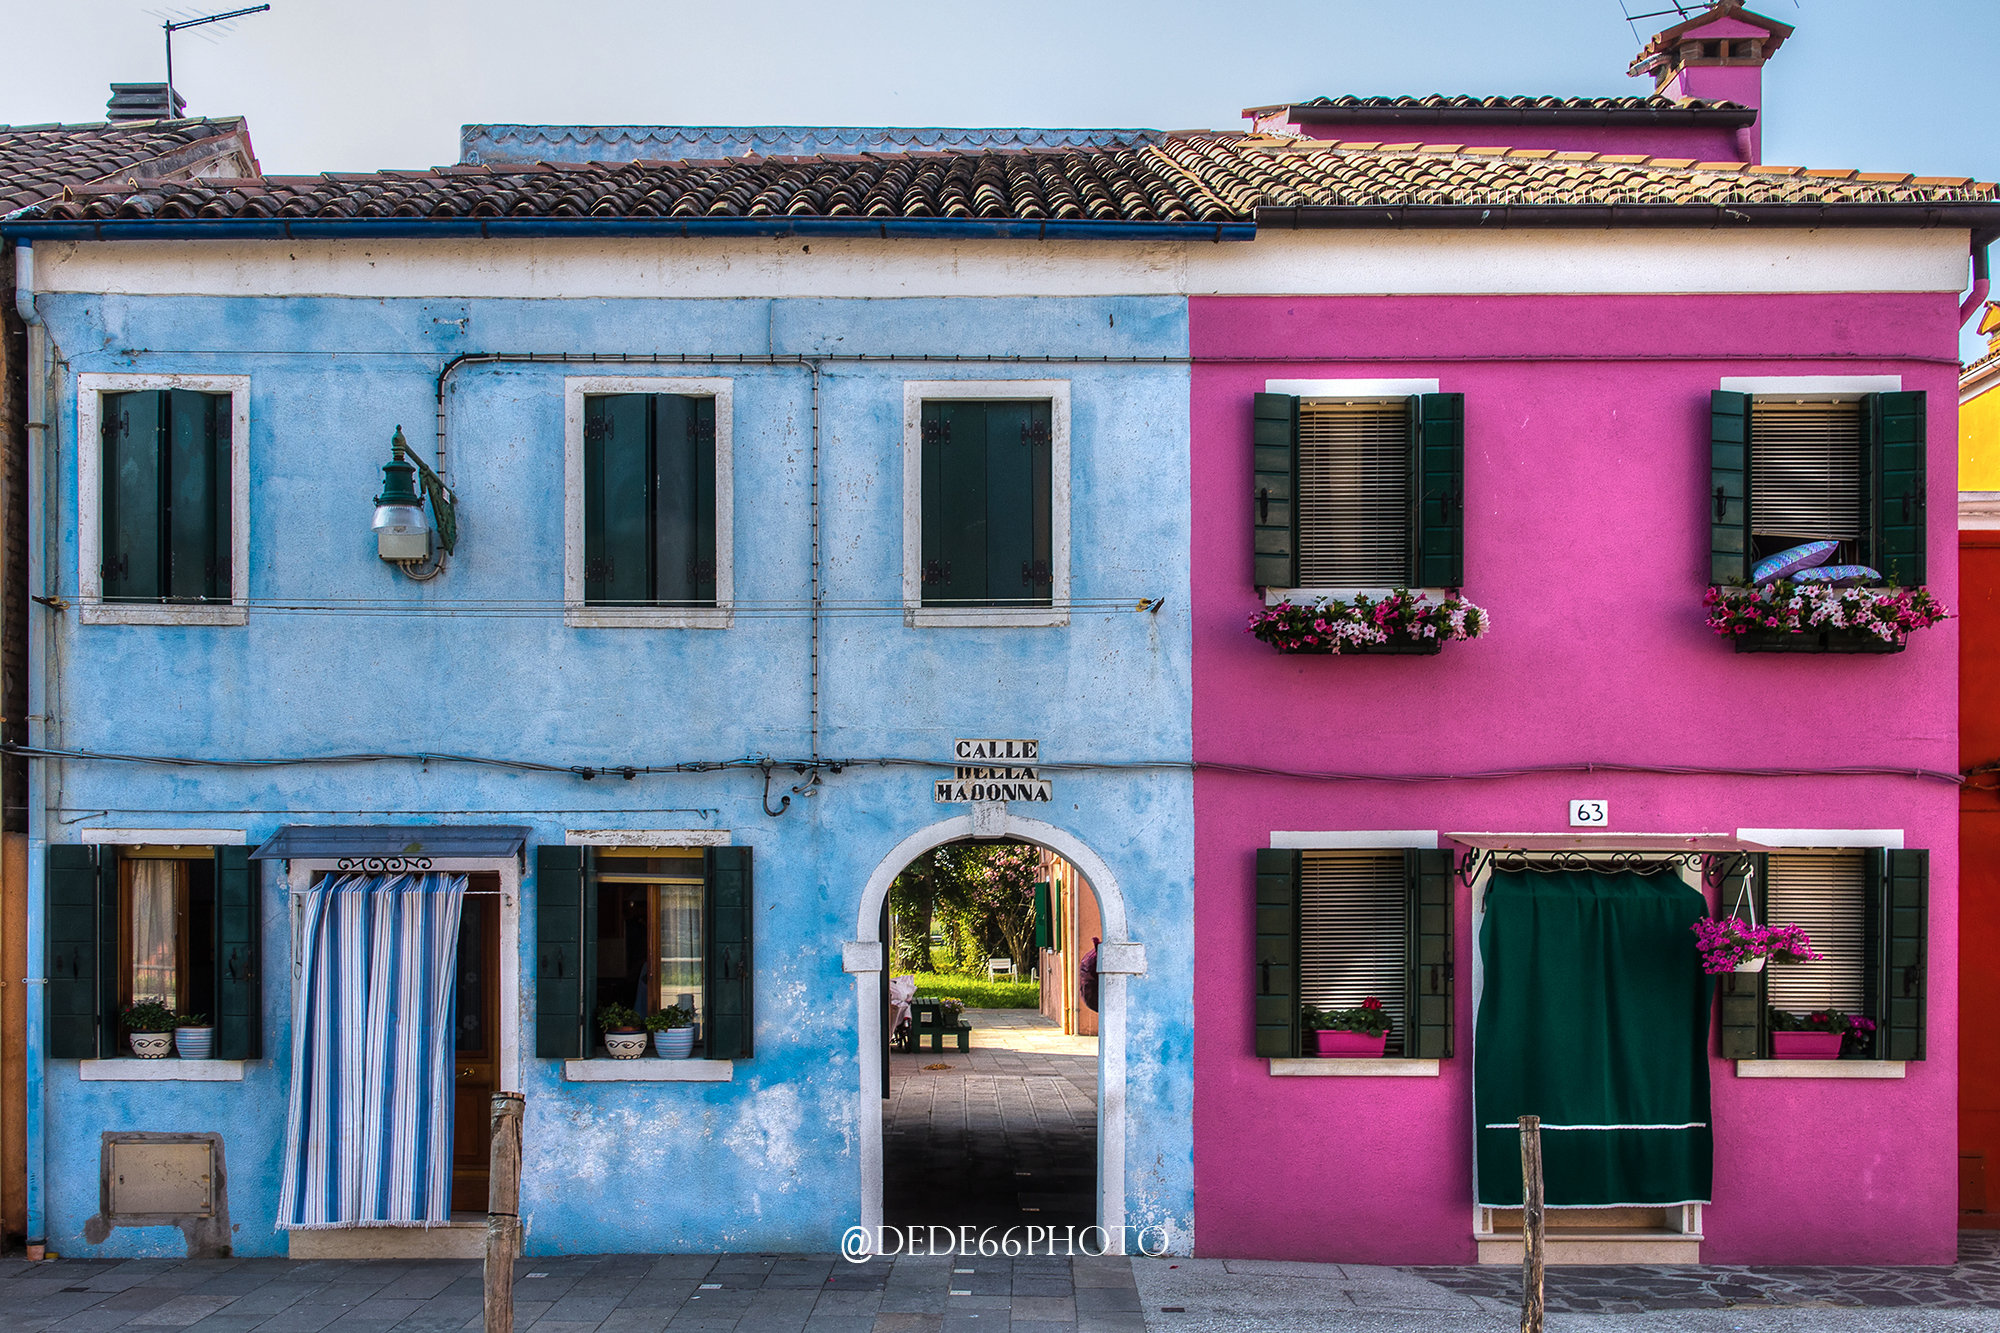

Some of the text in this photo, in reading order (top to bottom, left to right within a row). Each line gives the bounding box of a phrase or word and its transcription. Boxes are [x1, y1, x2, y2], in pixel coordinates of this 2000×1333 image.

[956, 741, 1037, 758] CALLE
[956, 766, 1035, 779] DELLA
[937, 784, 1049, 801] MADONNA
[1578, 804, 1603, 821] 63
